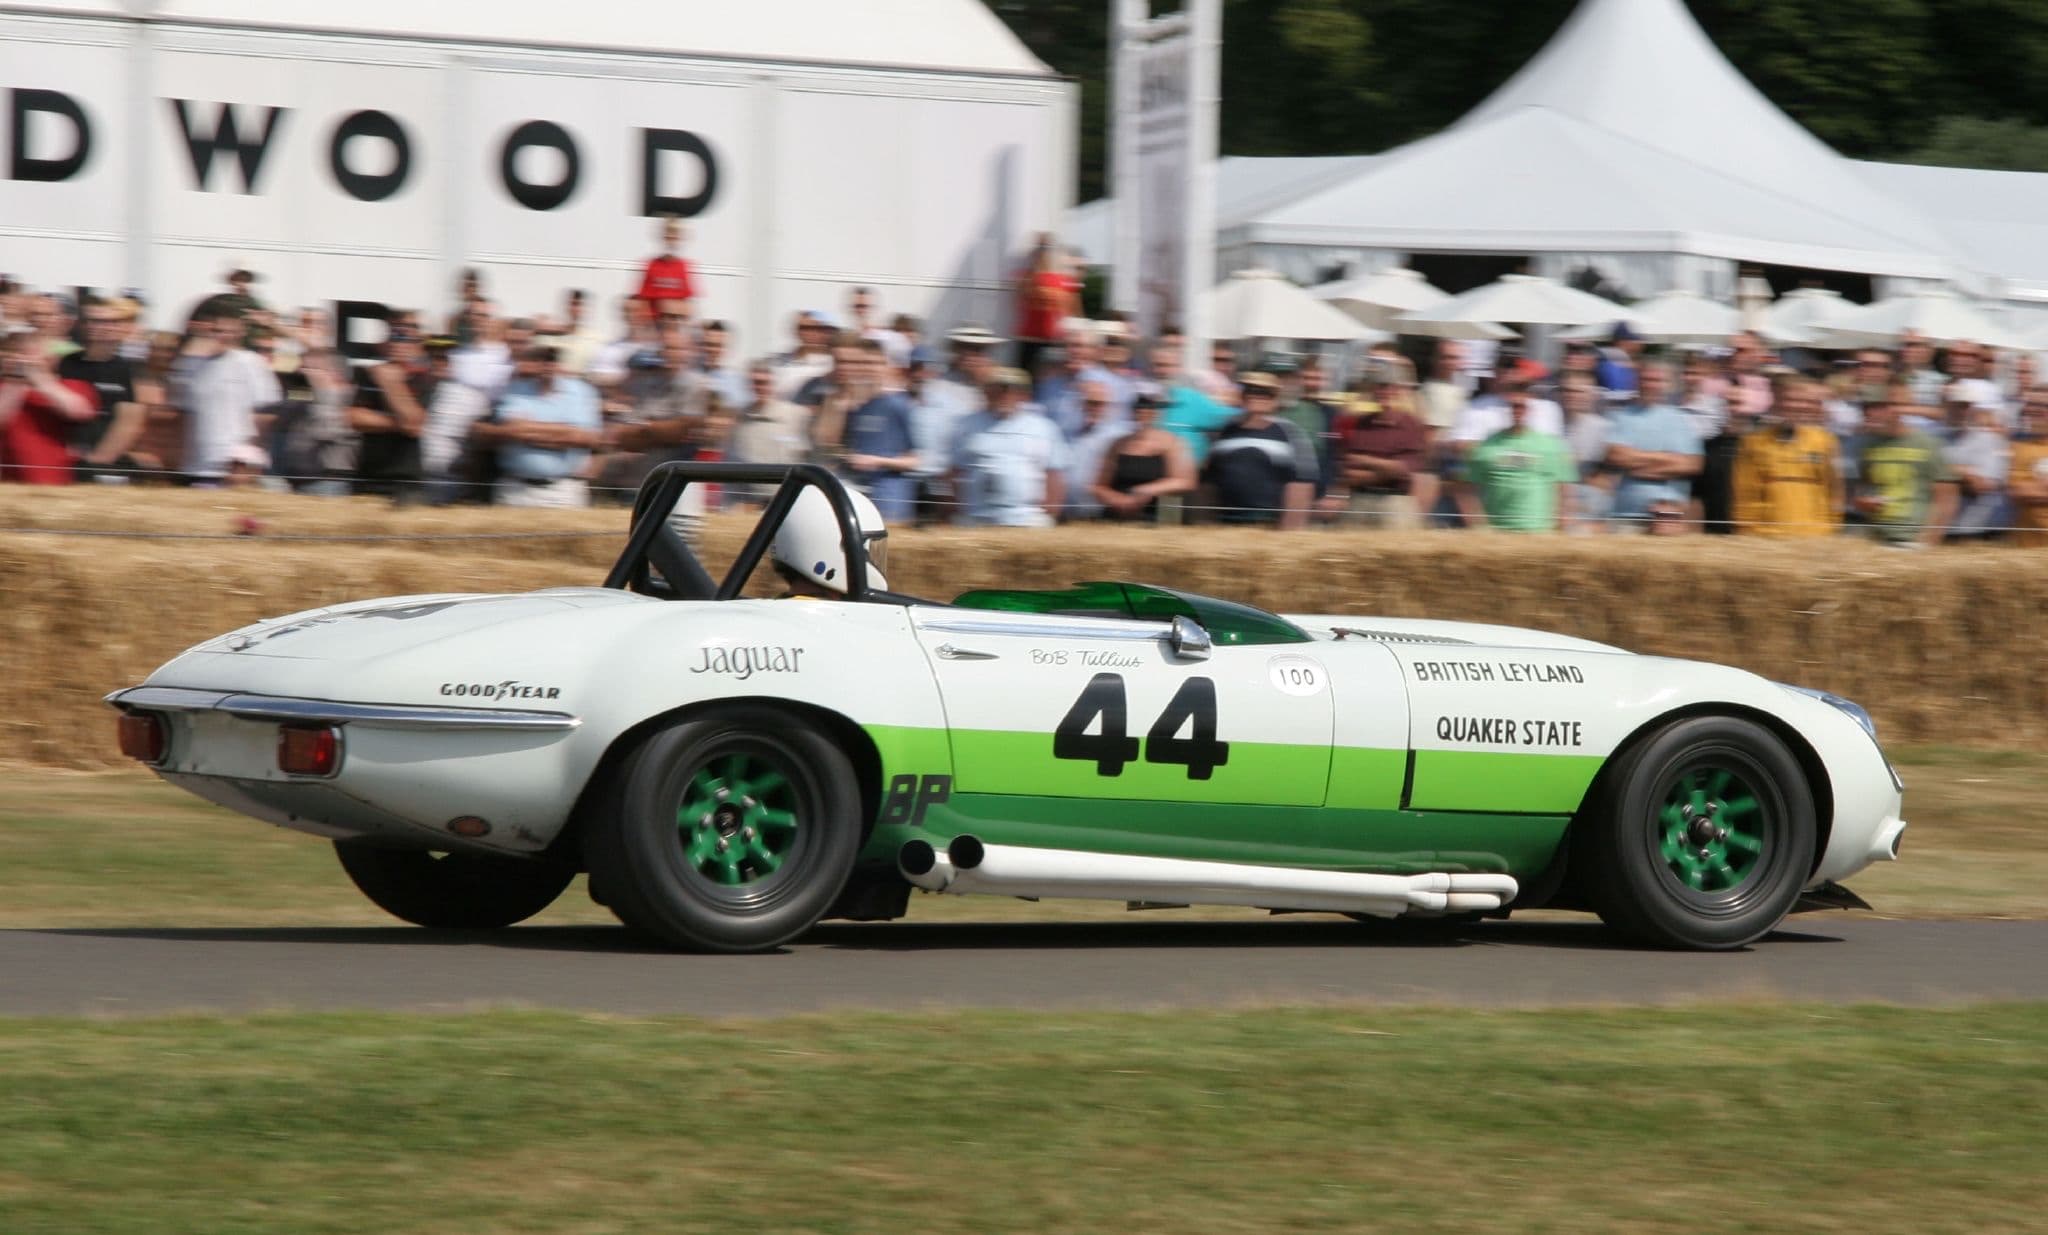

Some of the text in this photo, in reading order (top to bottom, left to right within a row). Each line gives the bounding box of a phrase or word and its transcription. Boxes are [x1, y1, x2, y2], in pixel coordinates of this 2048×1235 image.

[1076, 650, 1145, 668] Tullius
[1279, 668, 1315, 686] 100
[1413, 661, 1584, 684] BRITISH LEYLAND
[439, 680, 561, 701] GOODYEAR
[1053, 672, 1230, 781] 44
[1436, 716, 1582, 746] QUAKER STATE
[880, 774, 953, 827] BP
